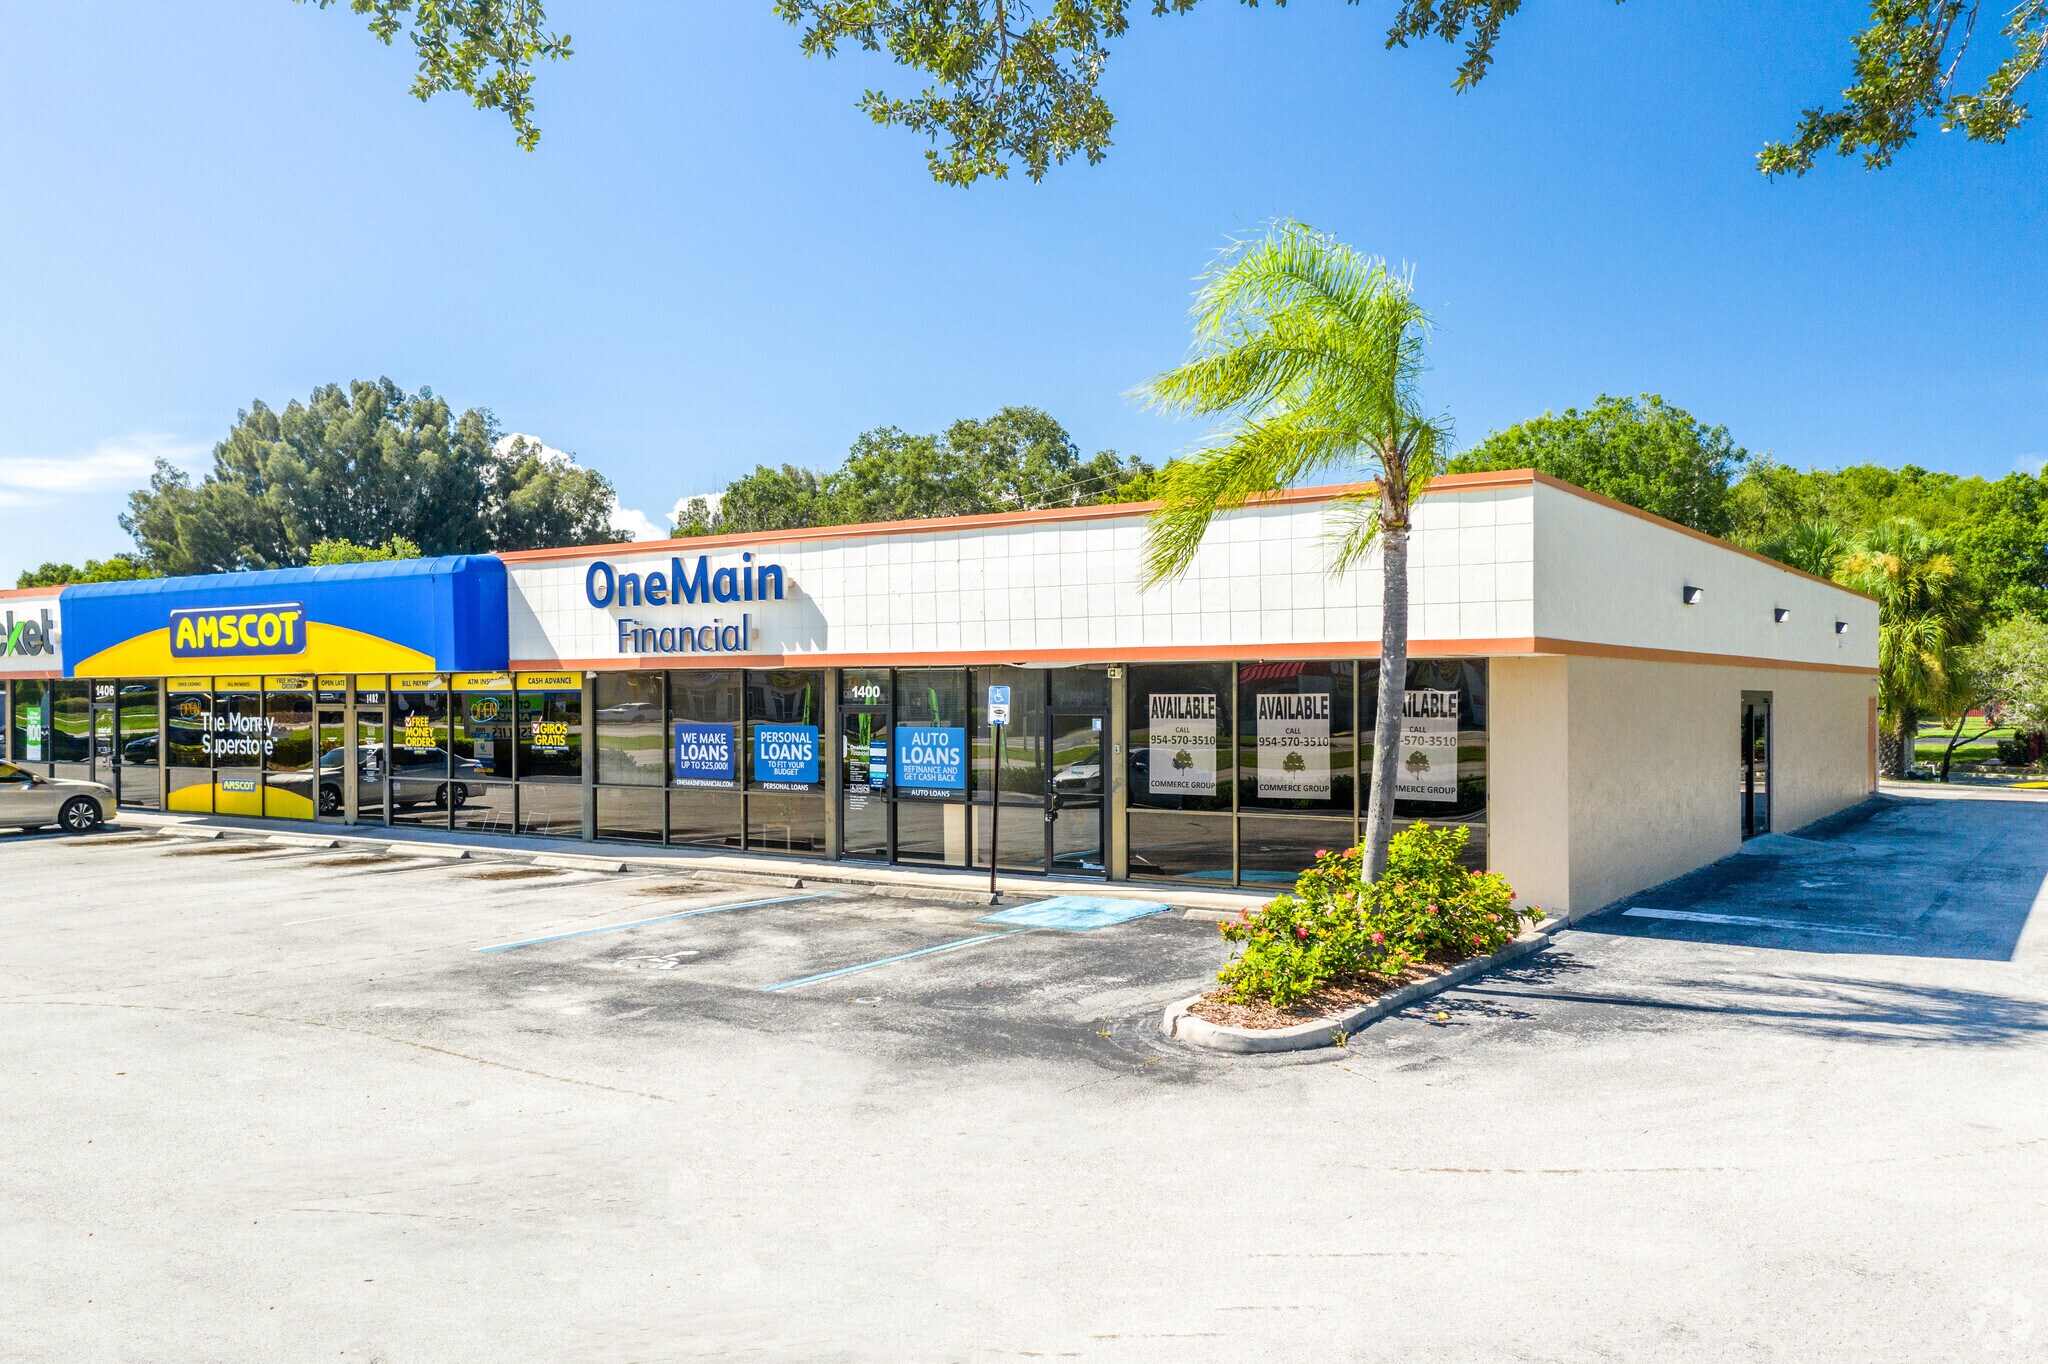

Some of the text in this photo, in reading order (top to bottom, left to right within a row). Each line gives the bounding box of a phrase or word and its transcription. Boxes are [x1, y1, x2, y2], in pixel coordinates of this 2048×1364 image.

[586, 551, 784, 609] OneMain
[176, 611, 299, 649] AMSCOT
[618, 613, 749, 653] Financial
[96, 685, 114, 696] 1406
[852, 686, 880, 698] 1400
[180, 702, 201, 715] OPEN
[470, 701, 498, 719] OPEN
[1151, 696, 1216, 719] AVAILABLE
[1259, 696, 1328, 720] AVAILABLE
[1402, 692, 1457, 718] ILABLE
[200, 712, 274, 736] The Money
[412, 716, 429, 727] FREE
[406, 727, 434, 737] MONEY
[540, 723, 568, 734] GIROS
[406, 737, 436, 747] ORDERS
[535, 735, 566, 746] GRATIS
[682, 732, 726, 744] WE MAKE
[760, 732, 812, 743] PERSONAL
[912, 732, 948, 746] AUTO
[1151, 735, 1216, 746] 954-570-3510
[1259, 736, 1328, 747] 954-570-3510
[1400, 736, 1456, 747] -570-3510
[202, 734, 274, 758] Superstore
[680, 744, 728, 761] LOANS
[760, 744, 812, 761] LOANS
[902, 746, 960, 766] LOANS
[691, 762, 700, 770] TO
[768, 760, 804, 768] TO FIT YOUR
[774, 768, 798, 776] BUDGET
[904, 766, 958, 774] REFINANCE AND
[918, 773, 936, 781] CASH
[938, 774, 956, 782] BACK
[224, 780, 254, 790] AMSCOT
[676, 780, 734, 788] ONEMAINFINANCIAL.COM
[1150, 780, 1216, 790] COMMERCE GROUP
[1260, 784, 1330, 793] COMMERCE GROUP
[1427, 786, 1456, 795] GROUP
